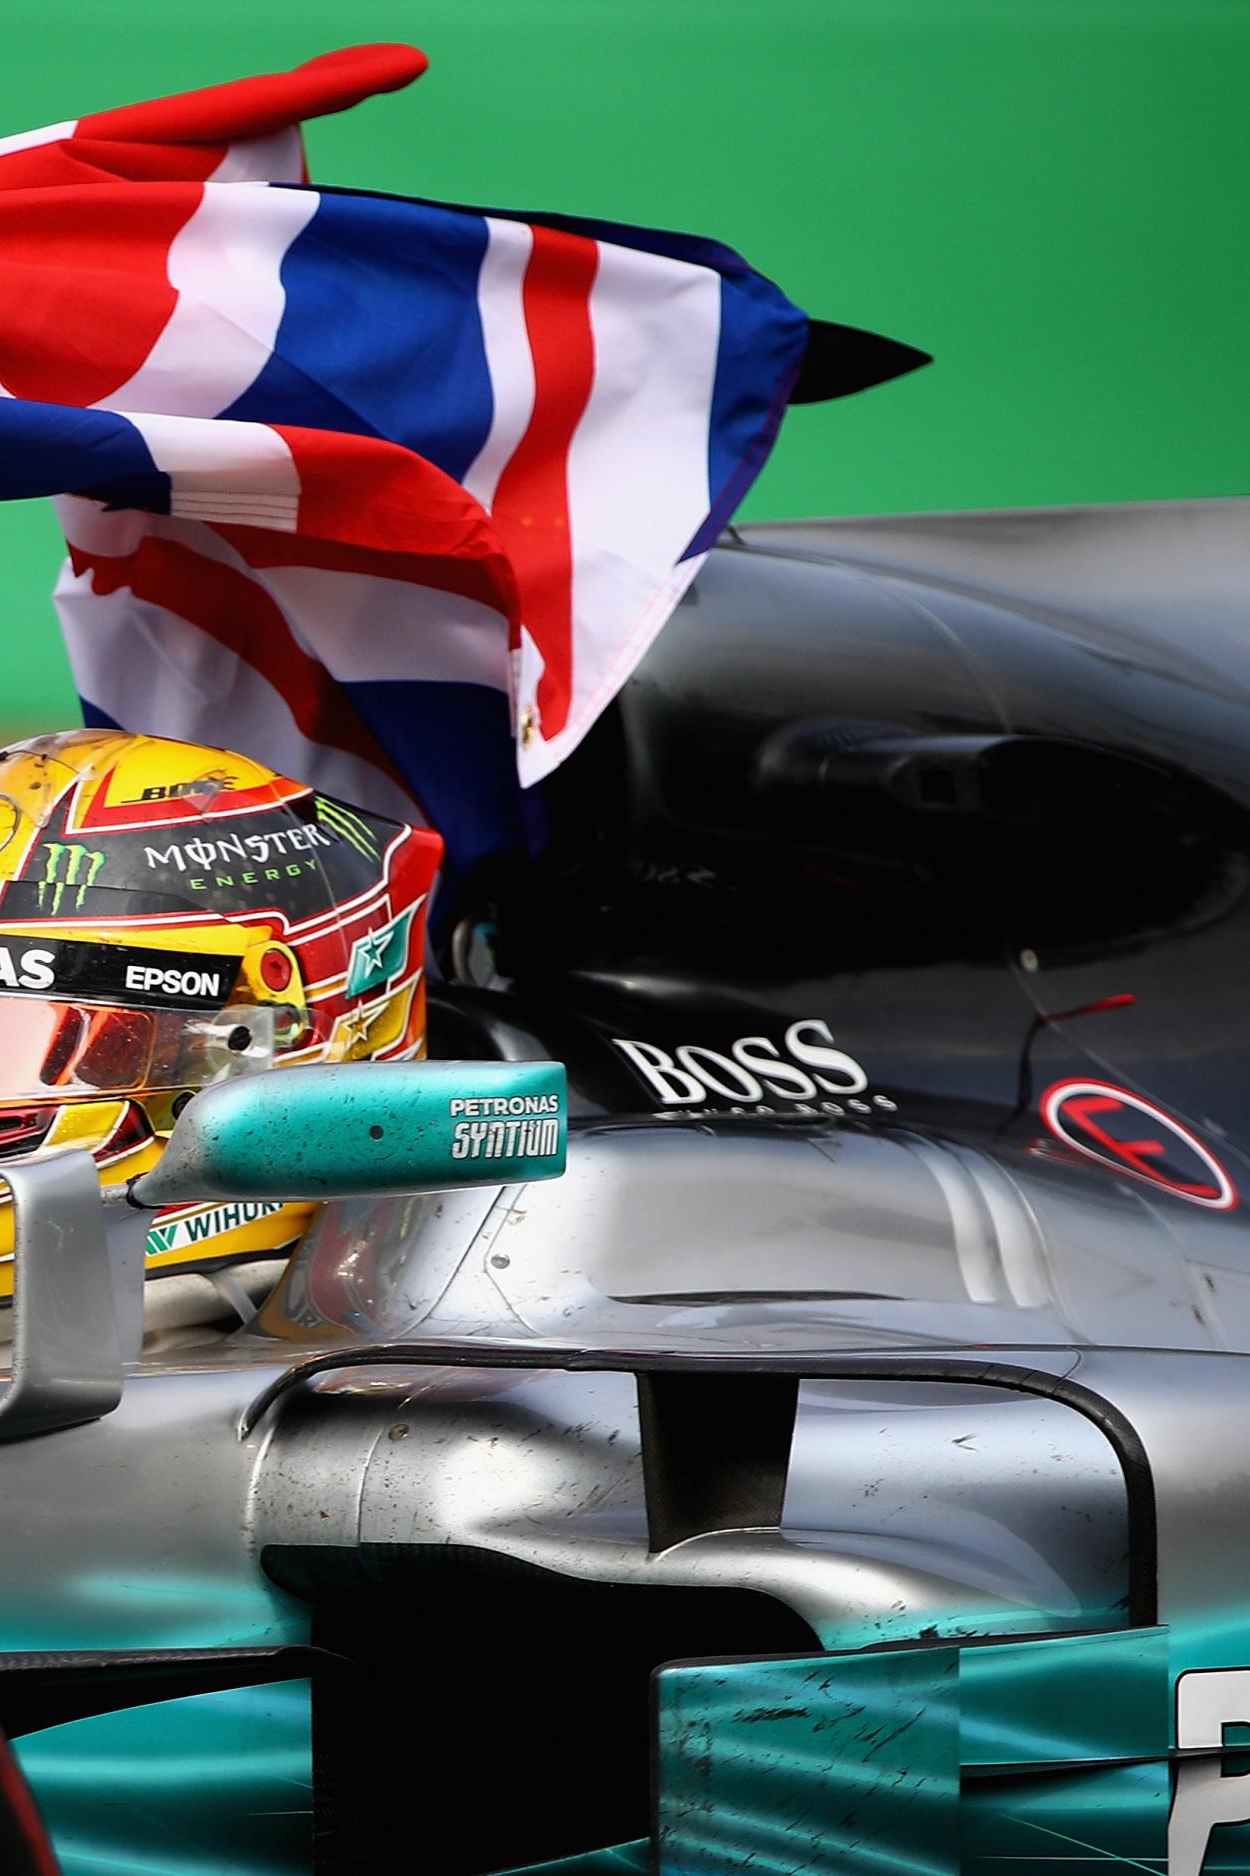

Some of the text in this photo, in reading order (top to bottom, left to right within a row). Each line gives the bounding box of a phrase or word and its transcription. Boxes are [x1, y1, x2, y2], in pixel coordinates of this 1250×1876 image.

[141, 776, 238, 802] BOE
[143, 823, 331, 872] MONSTER
[189, 859, 318, 890] ENERGY
[125, 965, 220, 996] EPSON
[611, 1019, 869, 1105] BOSS
[450, 1094, 559, 1117] PETRONAS
[451, 1118, 559, 1159] SYNTIUM
